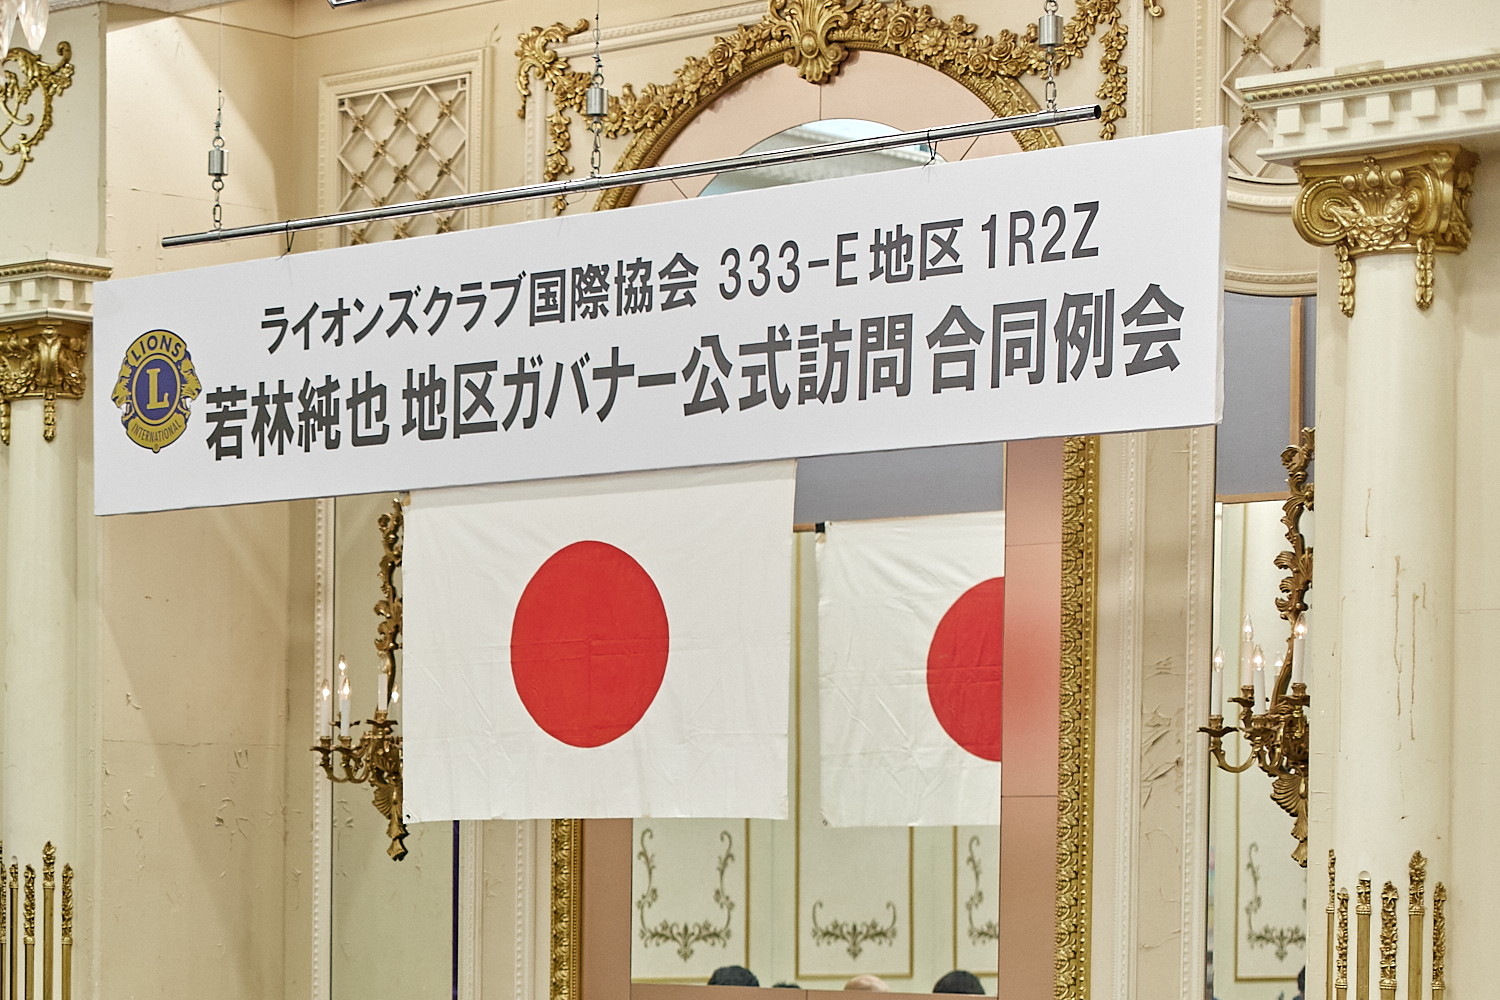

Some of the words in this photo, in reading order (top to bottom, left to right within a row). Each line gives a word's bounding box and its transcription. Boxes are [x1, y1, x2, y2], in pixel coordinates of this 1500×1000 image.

[261, 252, 699, 354] ライオンズクラブ国際協会
[981, 201, 1099, 269] 1R2Z
[130, 334, 183, 361] LIONS
[146, 368, 170, 410] L
[205, 370, 390, 461] 若林純也
[925, 283, 1185, 395] 合同例会
[130, 420, 182, 446] INTERNATIONAL
